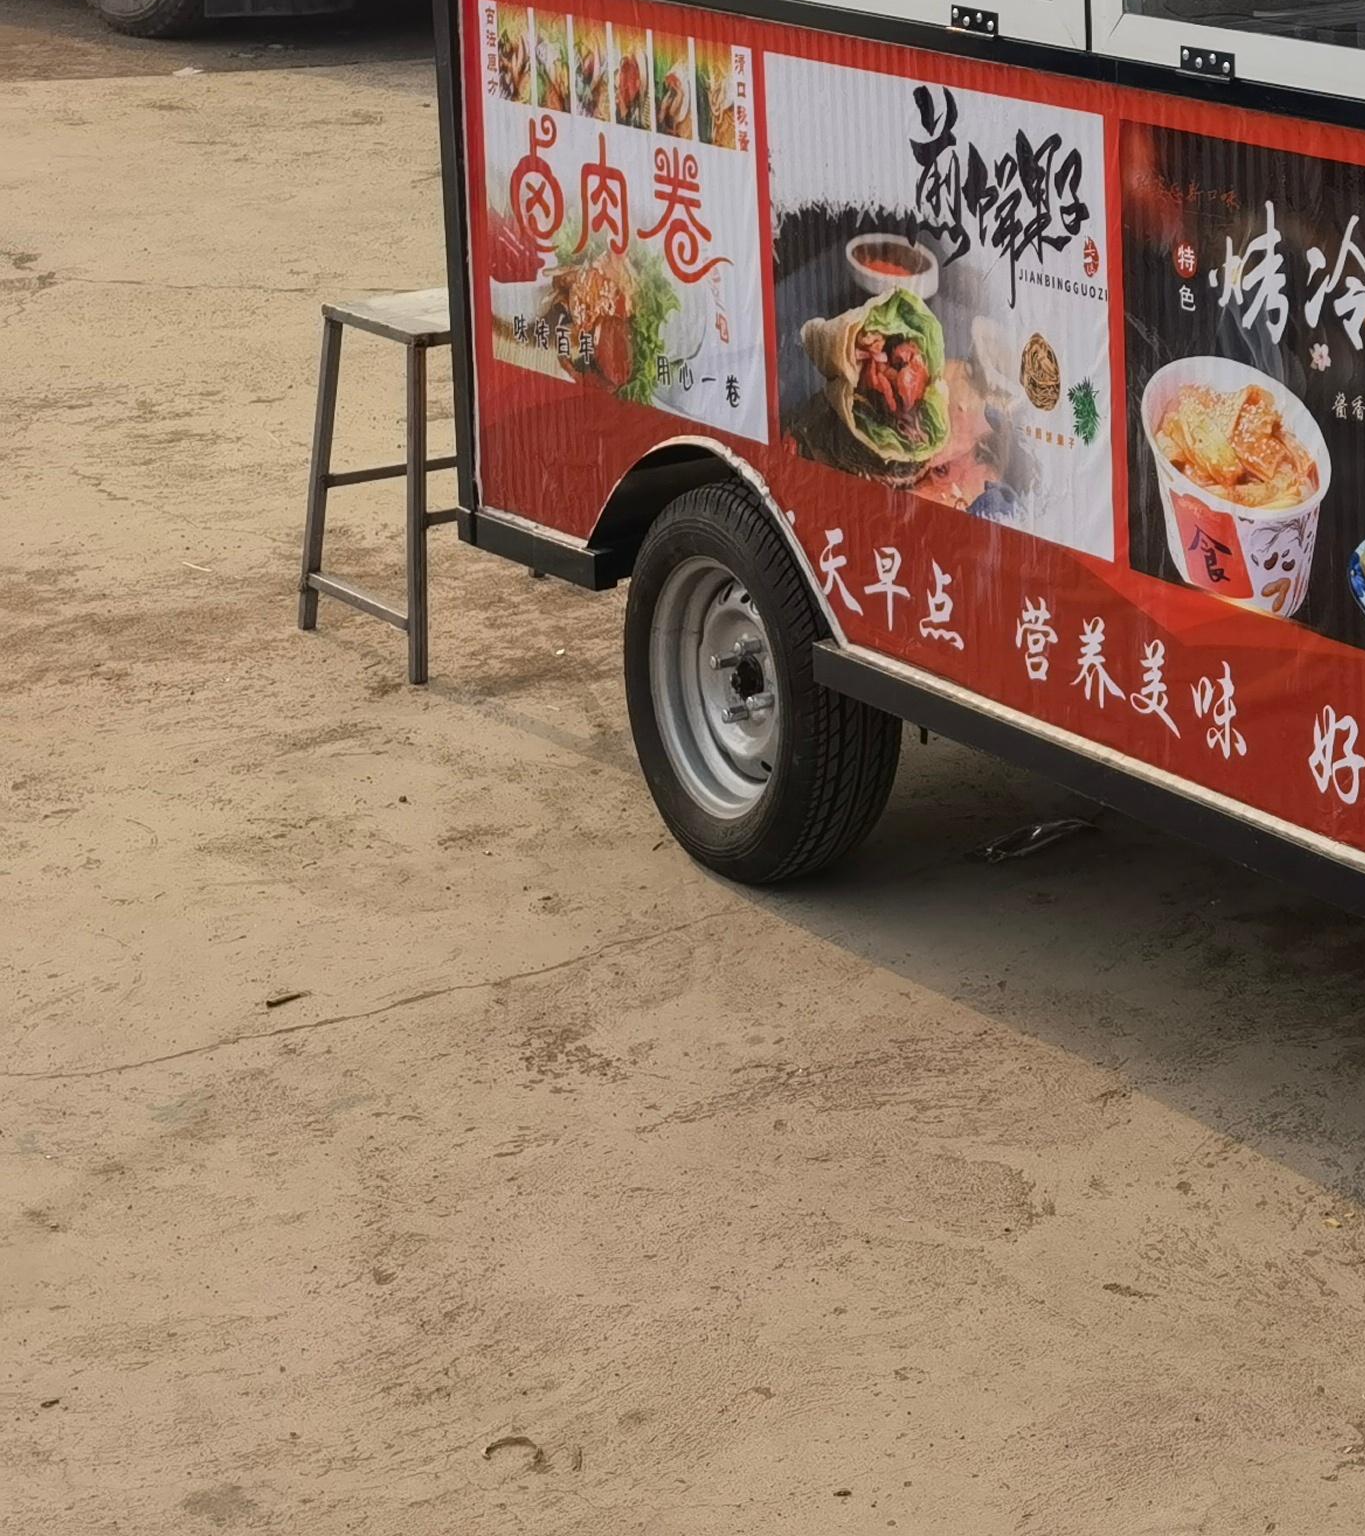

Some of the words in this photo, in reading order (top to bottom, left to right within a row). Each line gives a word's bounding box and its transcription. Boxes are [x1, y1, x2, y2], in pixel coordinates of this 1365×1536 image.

[509, 114, 735, 284] 卤肉卷
[1018, 269, 1108, 302] JIANBINGGUOZI
[1177, 244, 1197, 312] 特色
[513, 314, 594, 364] 味传百年
[656, 355, 741, 408] 用心一卷
[1187, 524, 1232, 583] 食
[1014, 596, 1248, 760] 营养美味
